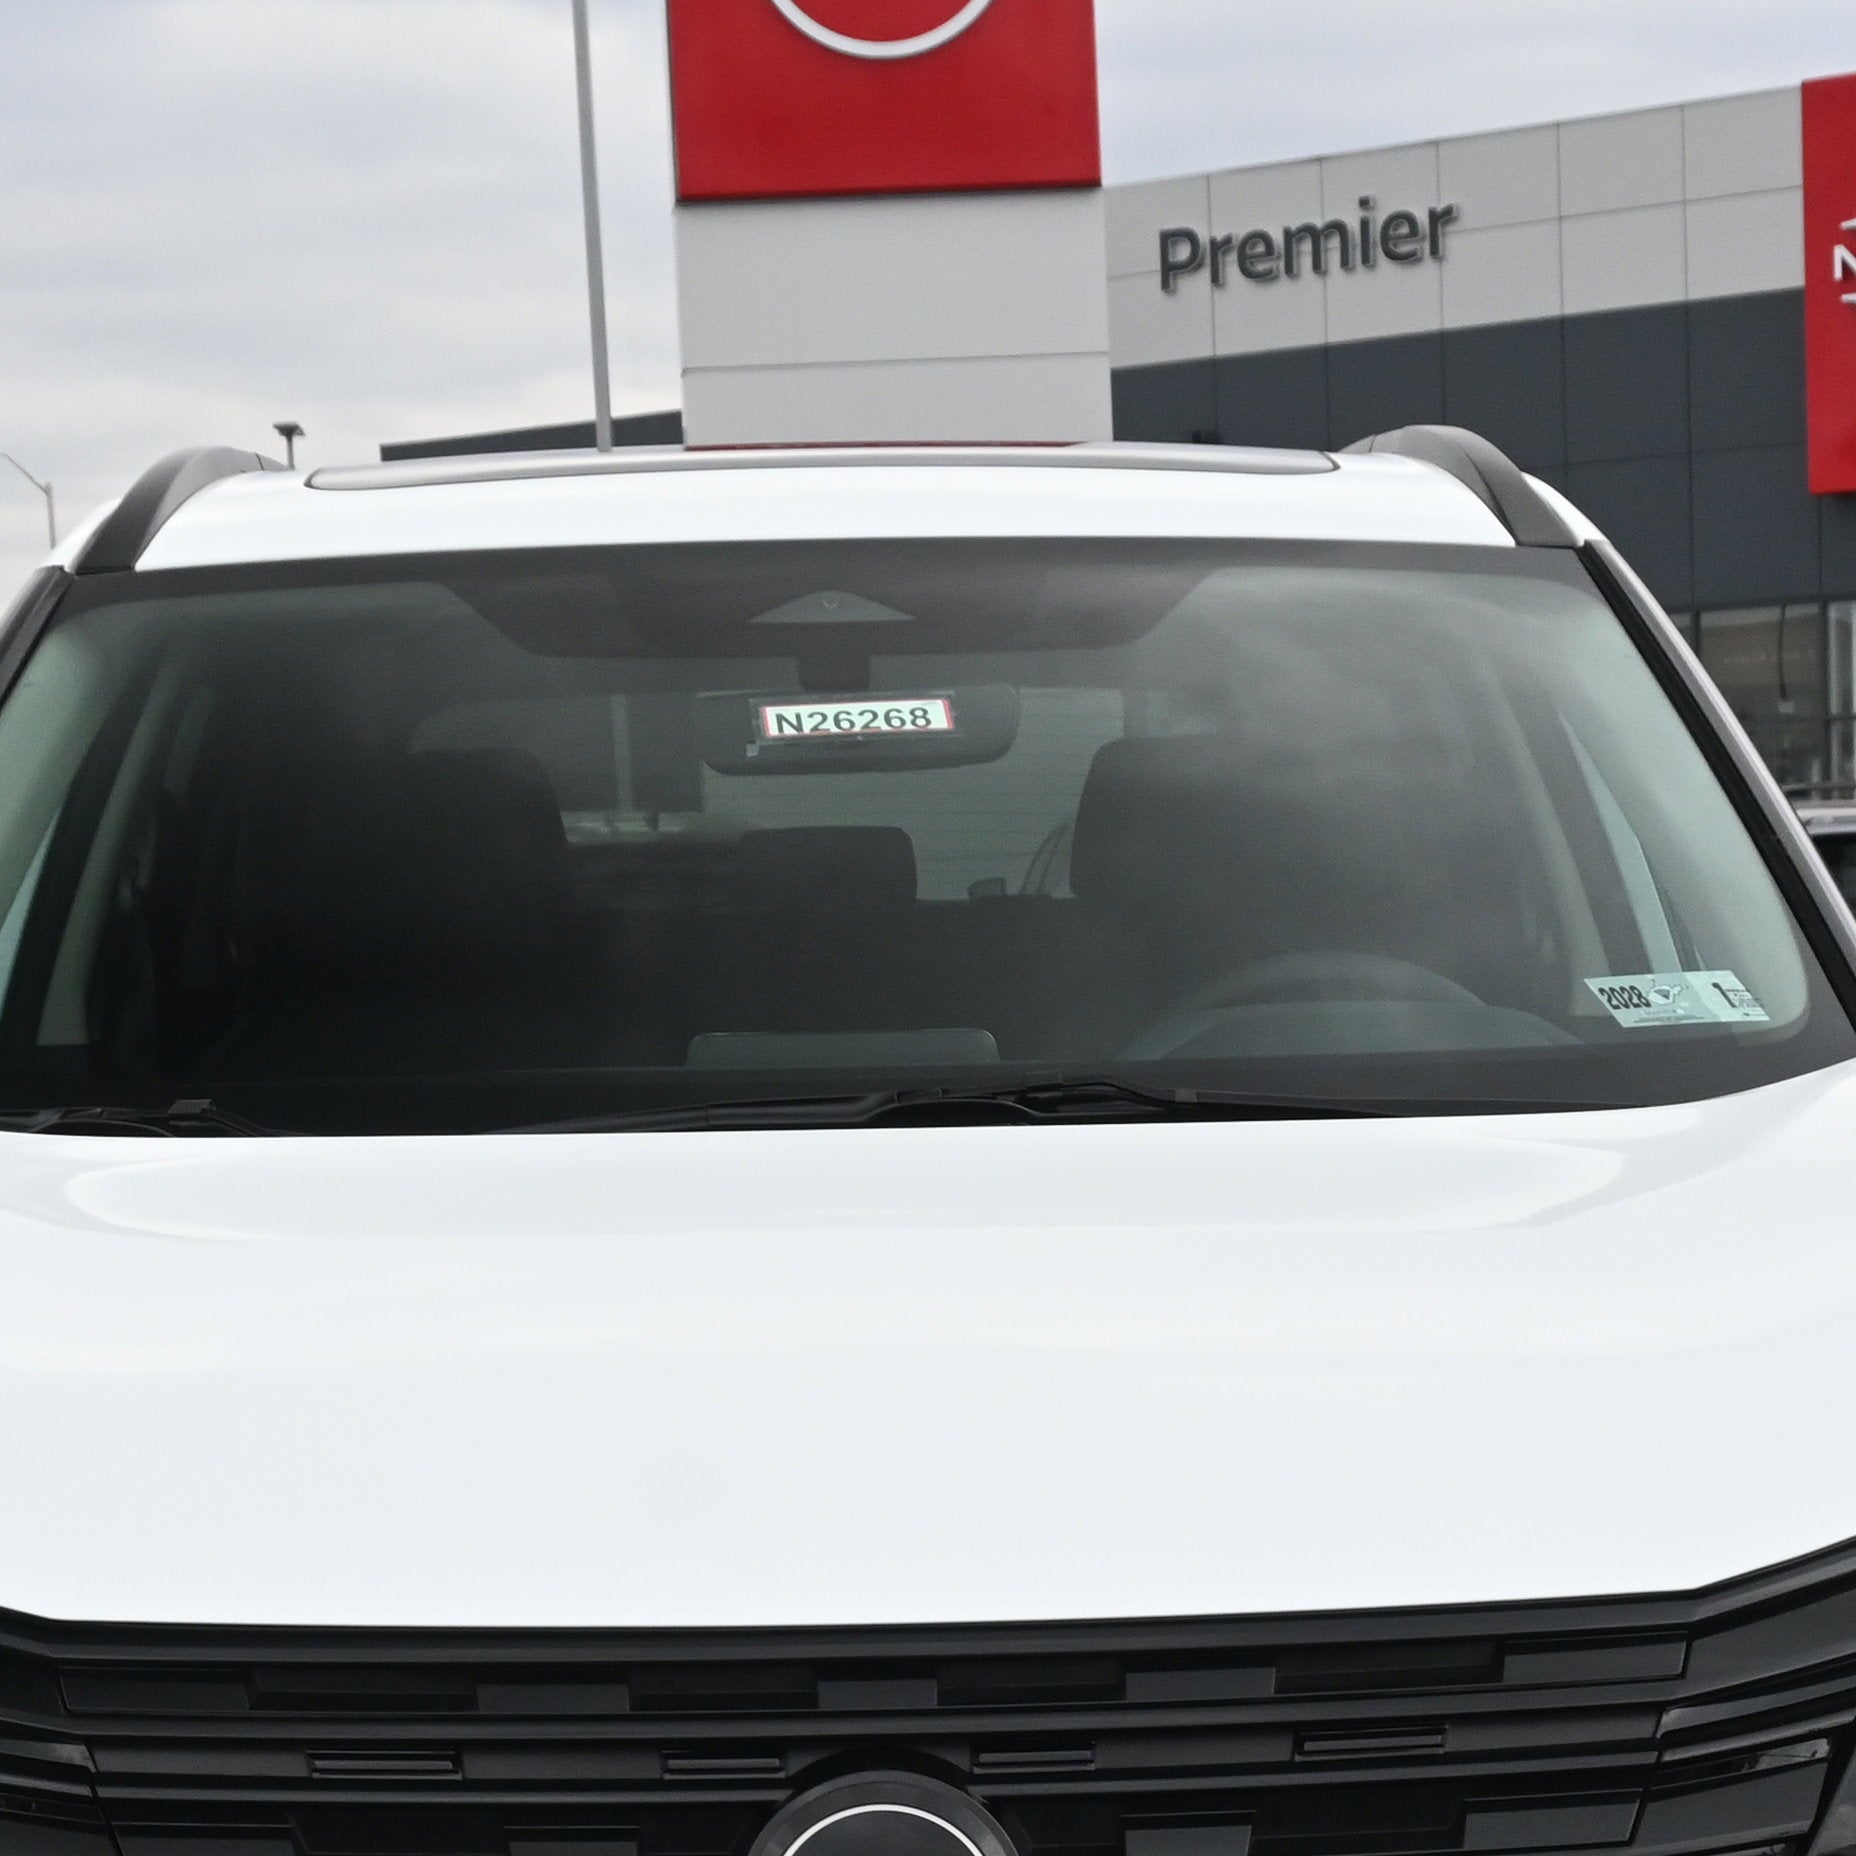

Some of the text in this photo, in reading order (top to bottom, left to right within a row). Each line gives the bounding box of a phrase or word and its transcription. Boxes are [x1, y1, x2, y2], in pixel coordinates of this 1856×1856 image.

[1159, 195, 1458, 293] Premier
[774, 707, 933, 734] N26268
[1597, 985, 1652, 1010] 2028
